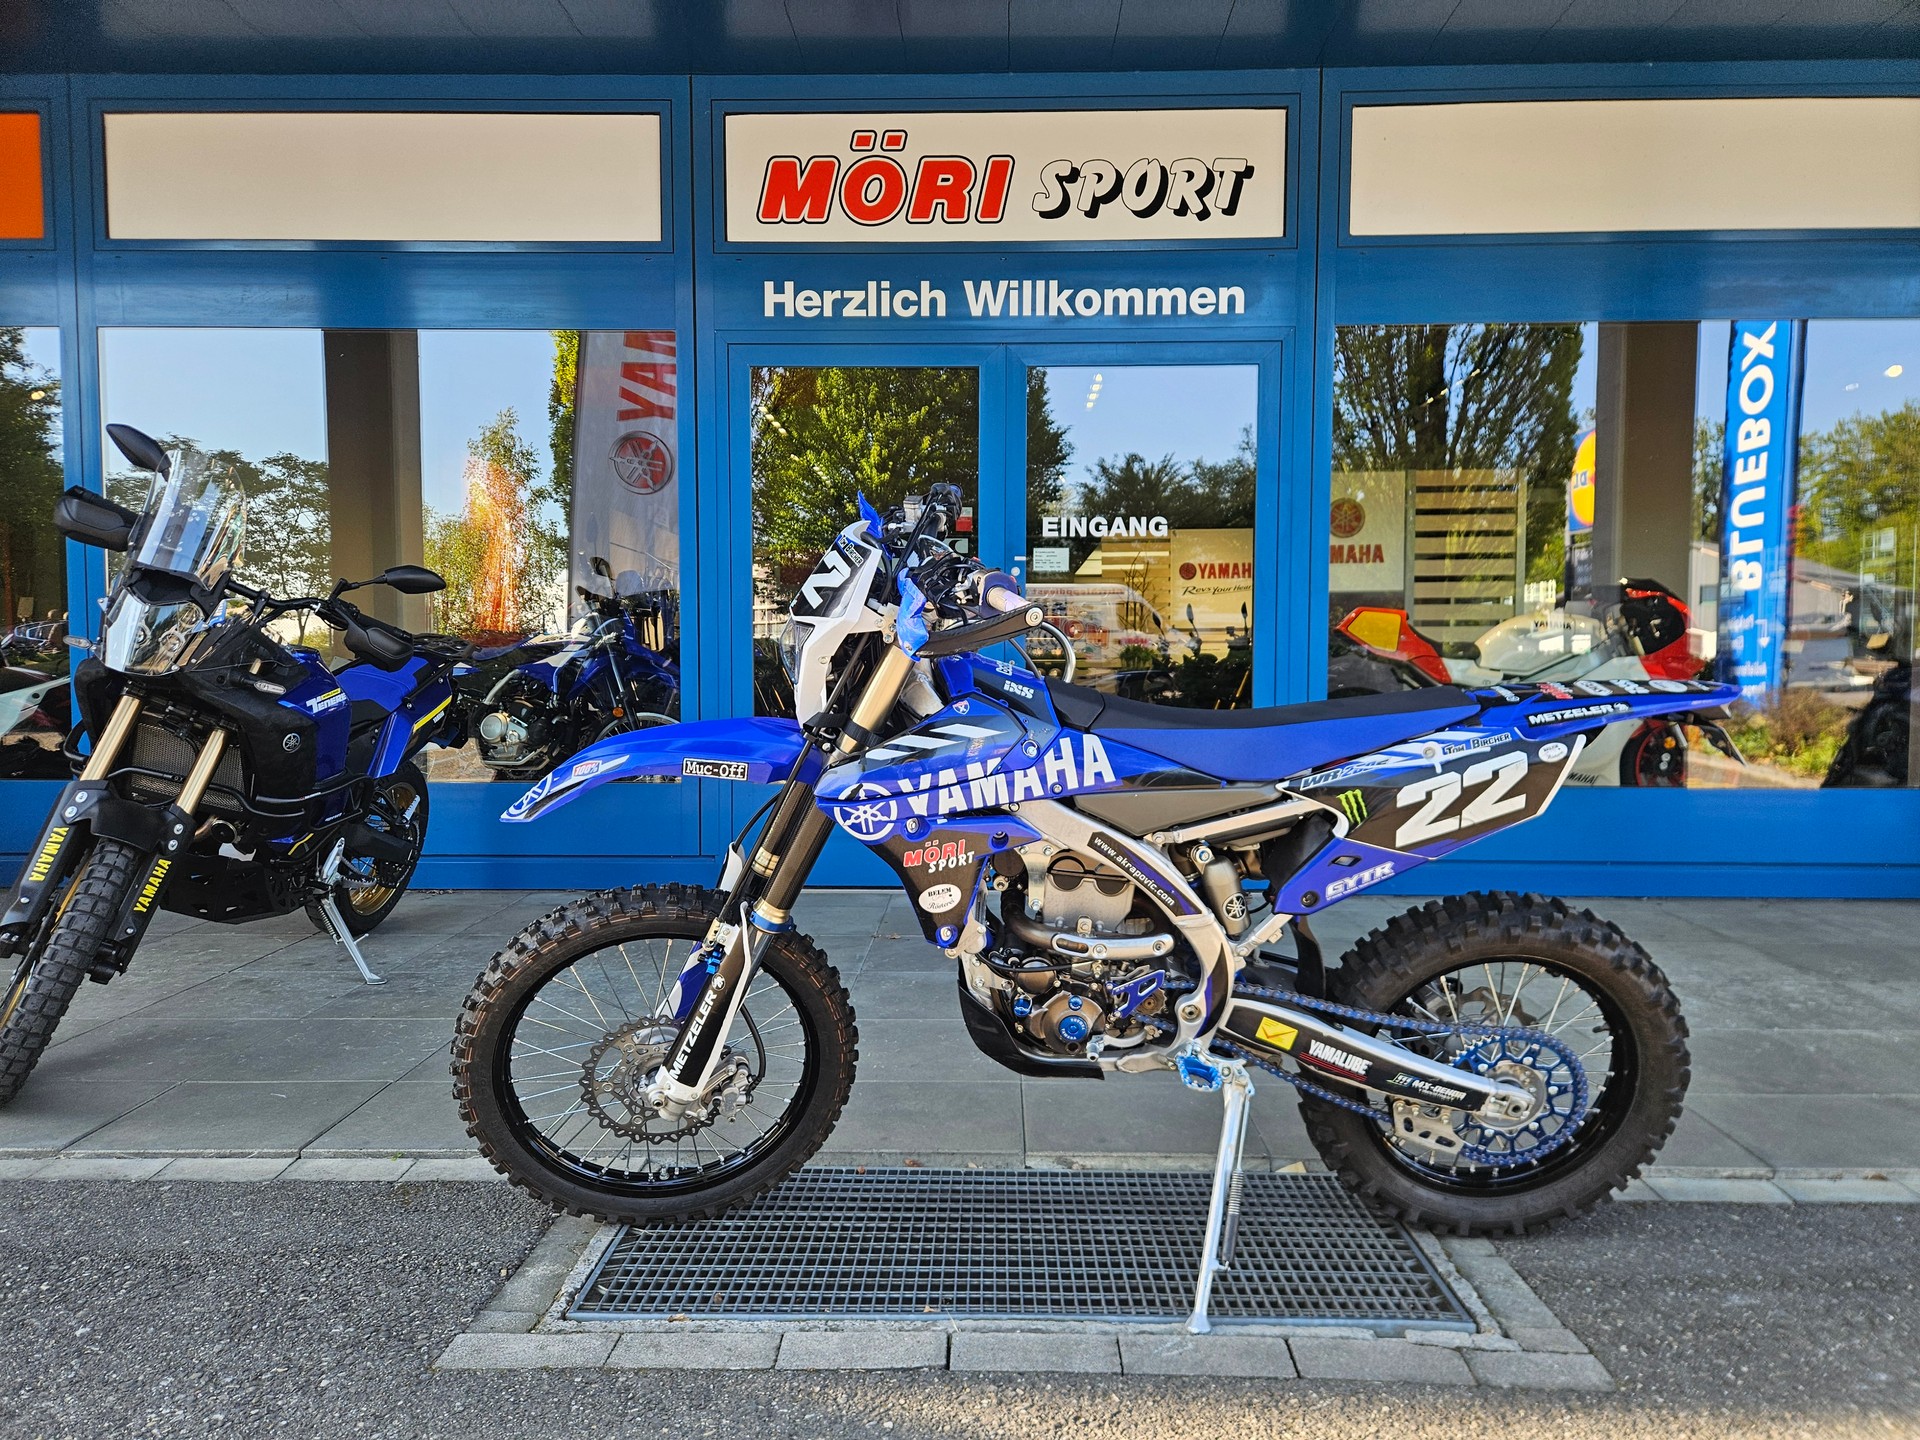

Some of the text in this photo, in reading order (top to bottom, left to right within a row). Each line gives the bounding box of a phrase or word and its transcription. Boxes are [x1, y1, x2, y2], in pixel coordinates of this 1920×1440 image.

[756, 129, 1255, 226] MÖRI SPORT
[763, 278, 1246, 318] Herzlich Willkommen
[1042, 516, 1169, 537] EINGANG
[1528, 703, 1613, 725] METZELER
[574, 762, 600, 776] 100%
[686, 760, 746, 779] Muc-Off
[897, 733, 1117, 817] YAMAHA
[1395, 750, 1529, 849] 22
[29, 827, 70, 882] YAMAHA
[903, 838, 966, 868] MÖRI
[927, 850, 975, 874] SPORT
[1094, 837, 1175, 906] www.akrapovic.com
[133, 859, 172, 913] YAMAHA
[1325, 861, 1396, 897] GYTR
[669, 990, 718, 1079] METZELER
[1308, 1039, 1372, 1075] YAMALUBE
